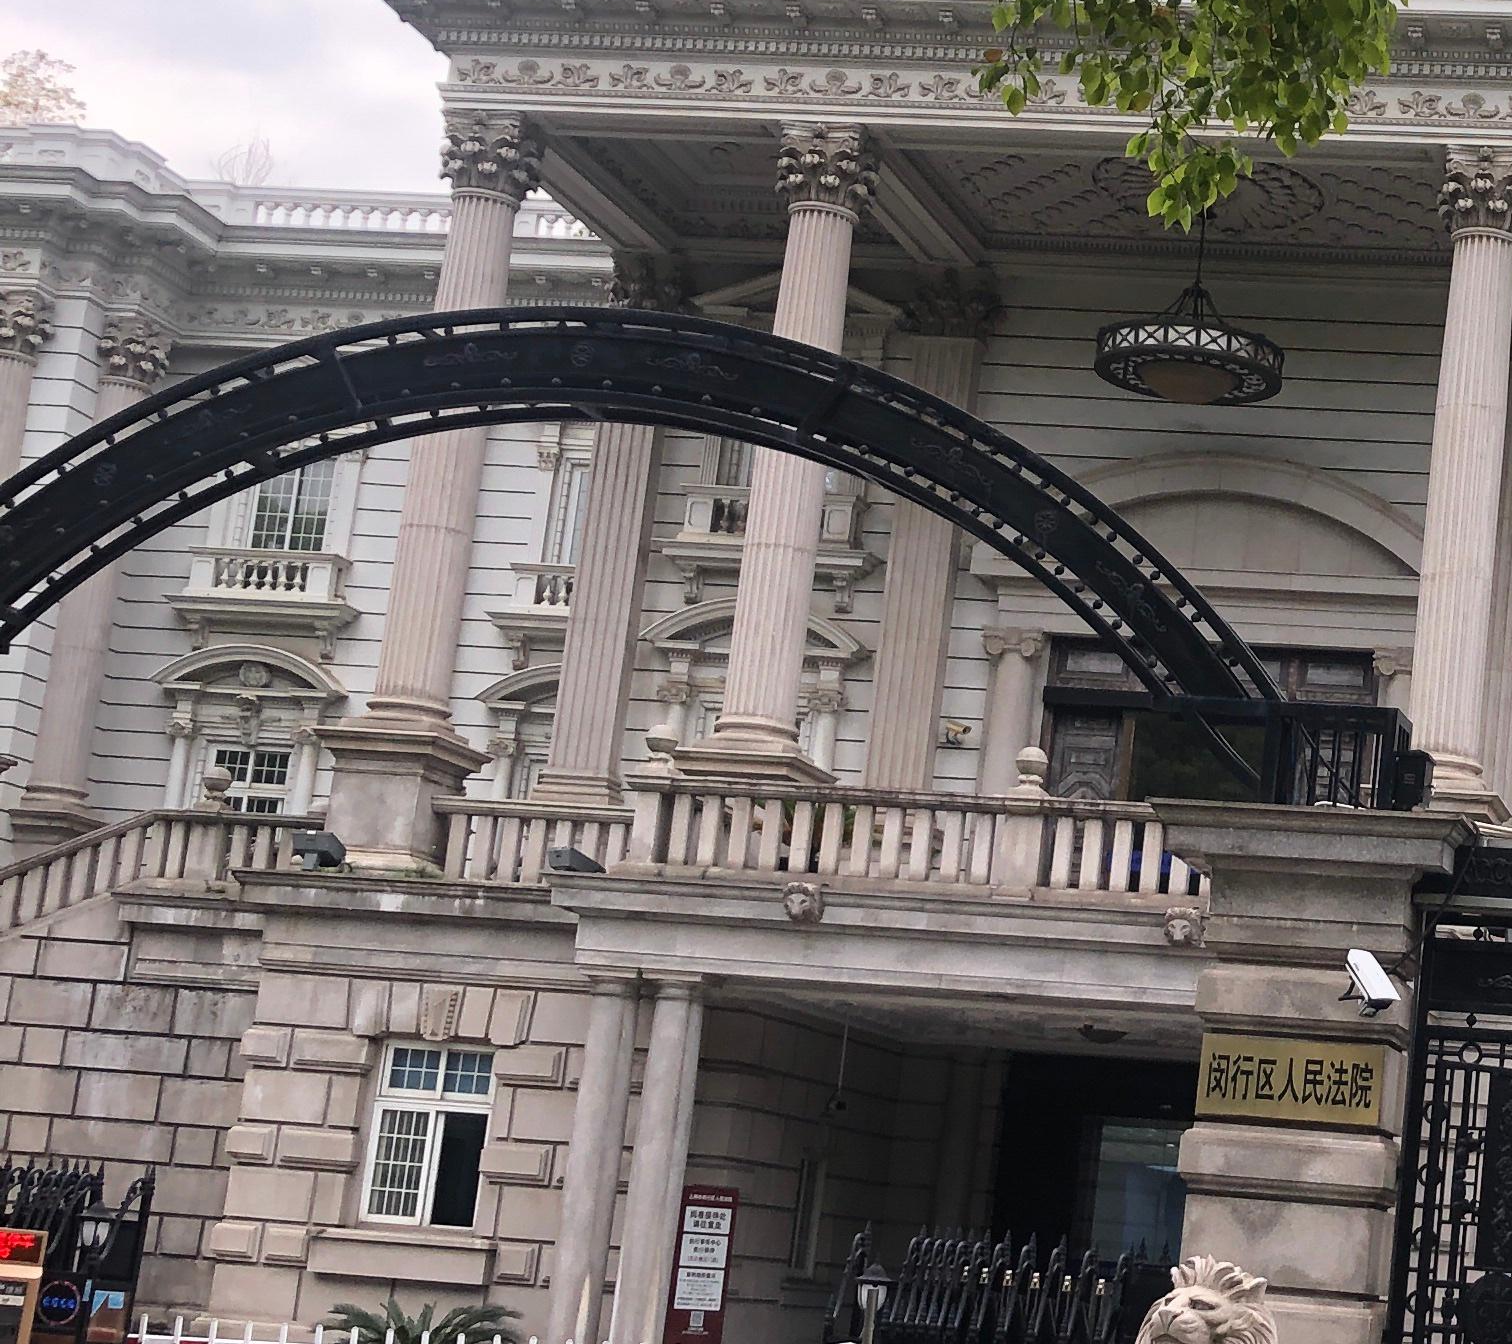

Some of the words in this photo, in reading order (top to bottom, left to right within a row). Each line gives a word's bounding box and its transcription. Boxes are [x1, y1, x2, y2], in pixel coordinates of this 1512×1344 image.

[1205, 1052, 1375, 1109] 闵行区人民法院
